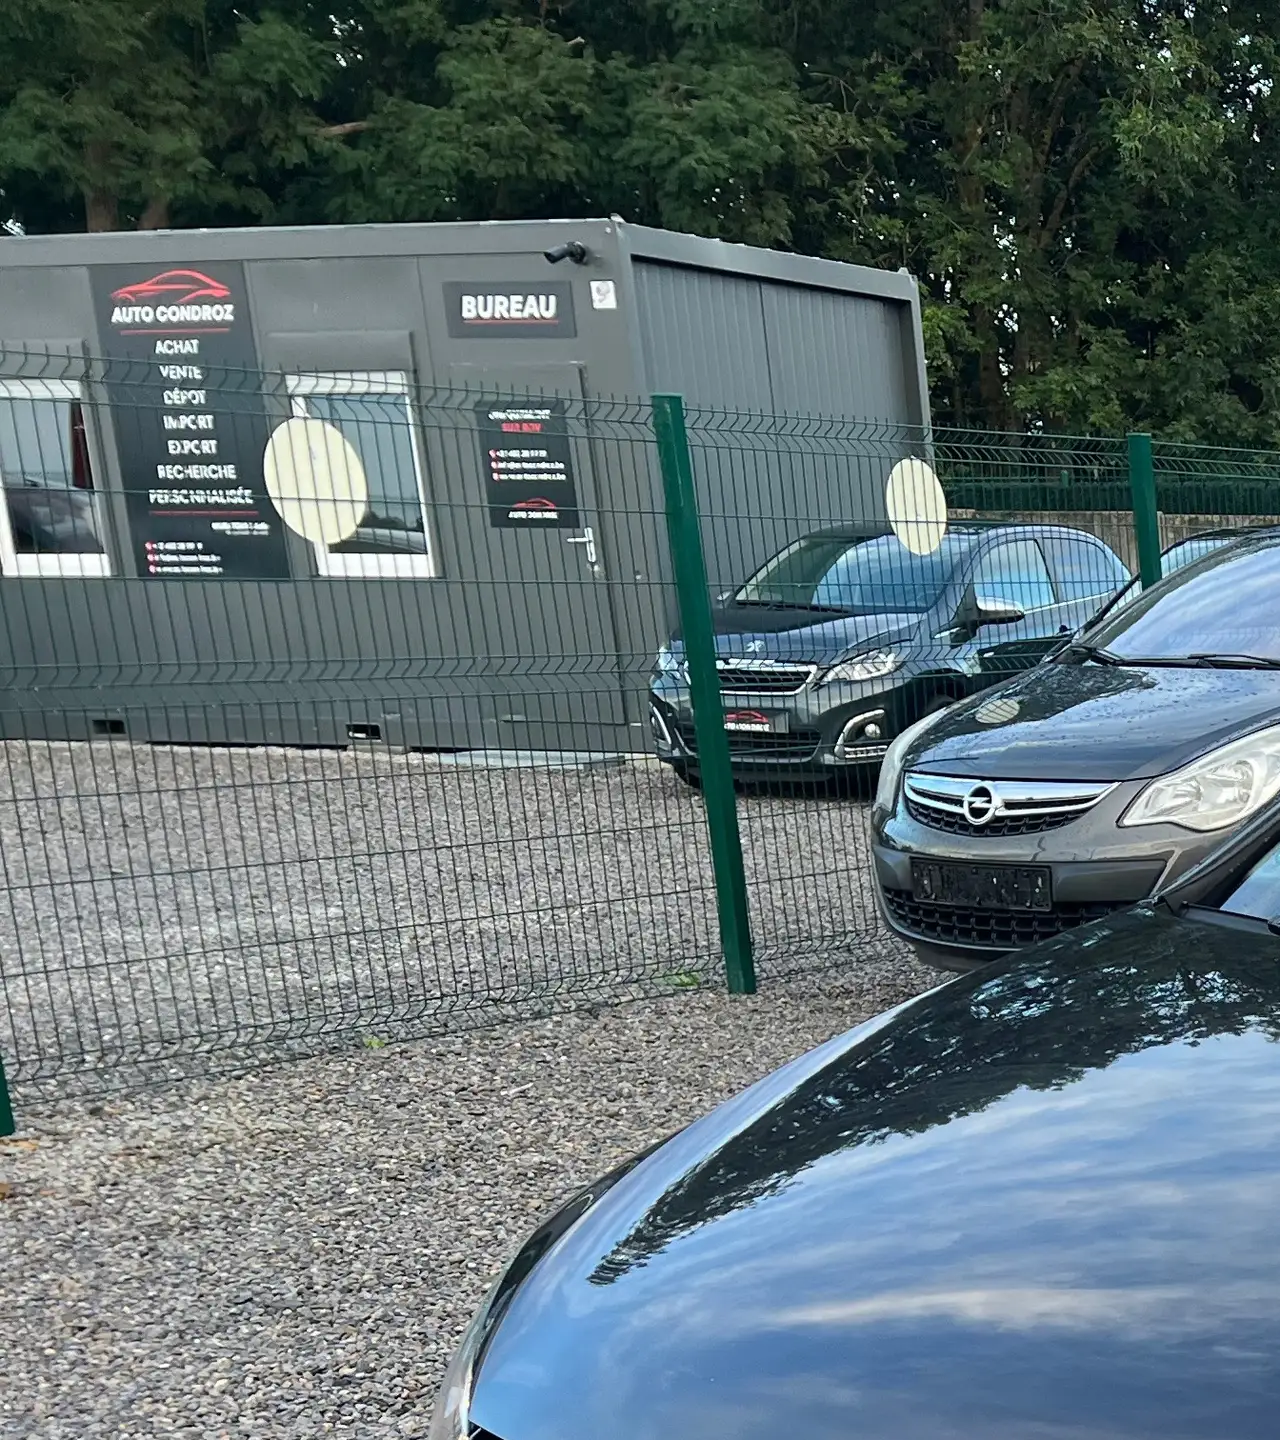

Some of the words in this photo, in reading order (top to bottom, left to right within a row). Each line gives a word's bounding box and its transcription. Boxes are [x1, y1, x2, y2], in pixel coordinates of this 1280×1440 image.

[111, 306, 154, 323] AUTO
[155, 304, 235, 322] CONDROZ
[461, 294, 558, 320] BUREAU
[155, 339, 200, 354] ACHAT
[159, 365, 203, 380] VENTE
[157, 464, 237, 479] RECHERCHE
